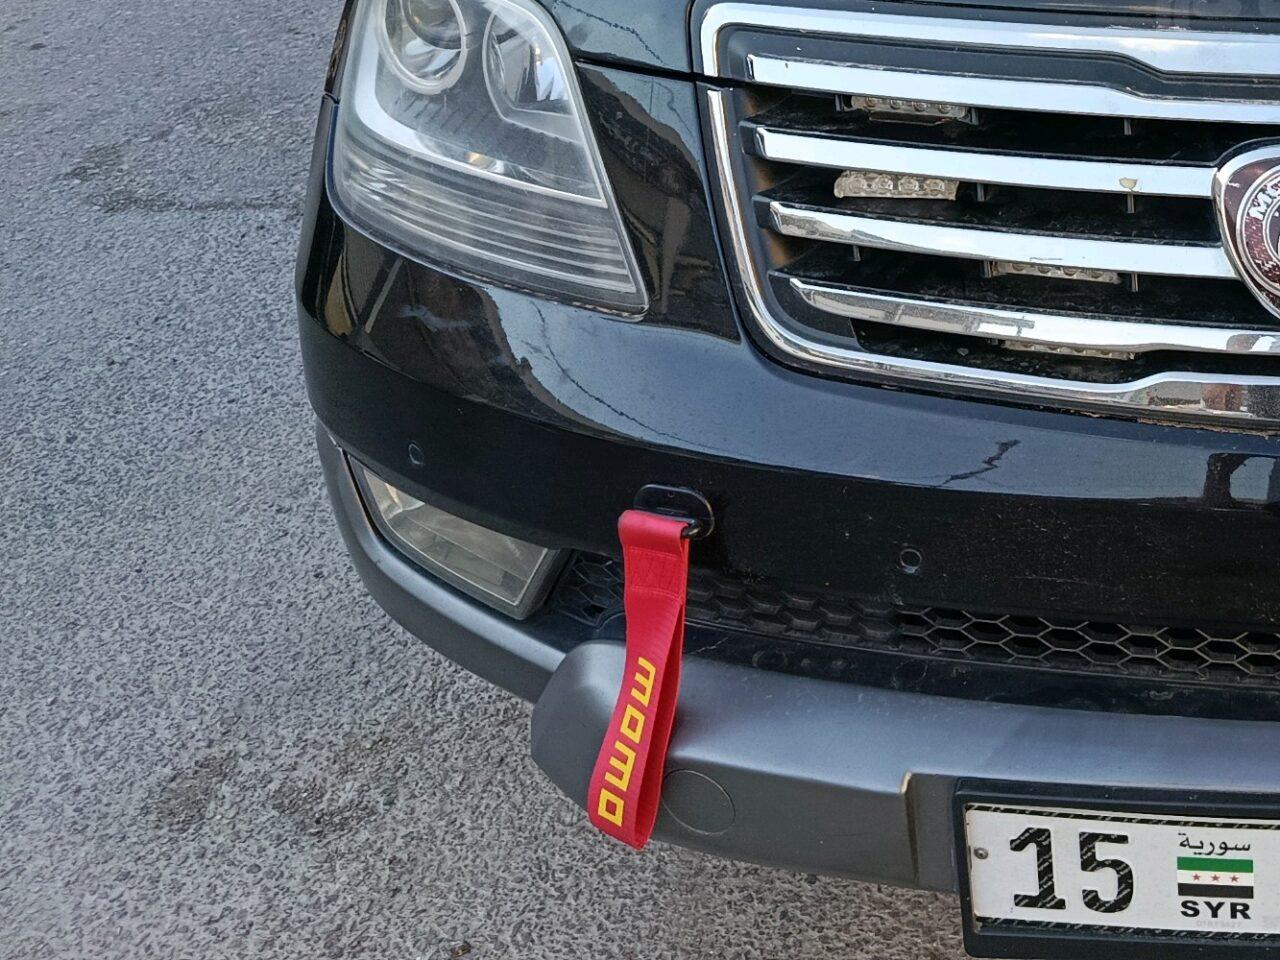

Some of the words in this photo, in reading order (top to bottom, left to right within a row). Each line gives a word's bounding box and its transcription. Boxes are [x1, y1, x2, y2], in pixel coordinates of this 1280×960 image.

[597, 656, 657, 828] MOMO
[1008, 827, 1135, 914] 15
[1177, 832, 1251, 856] سورية
[1180, 900, 1252, 919] SYR
